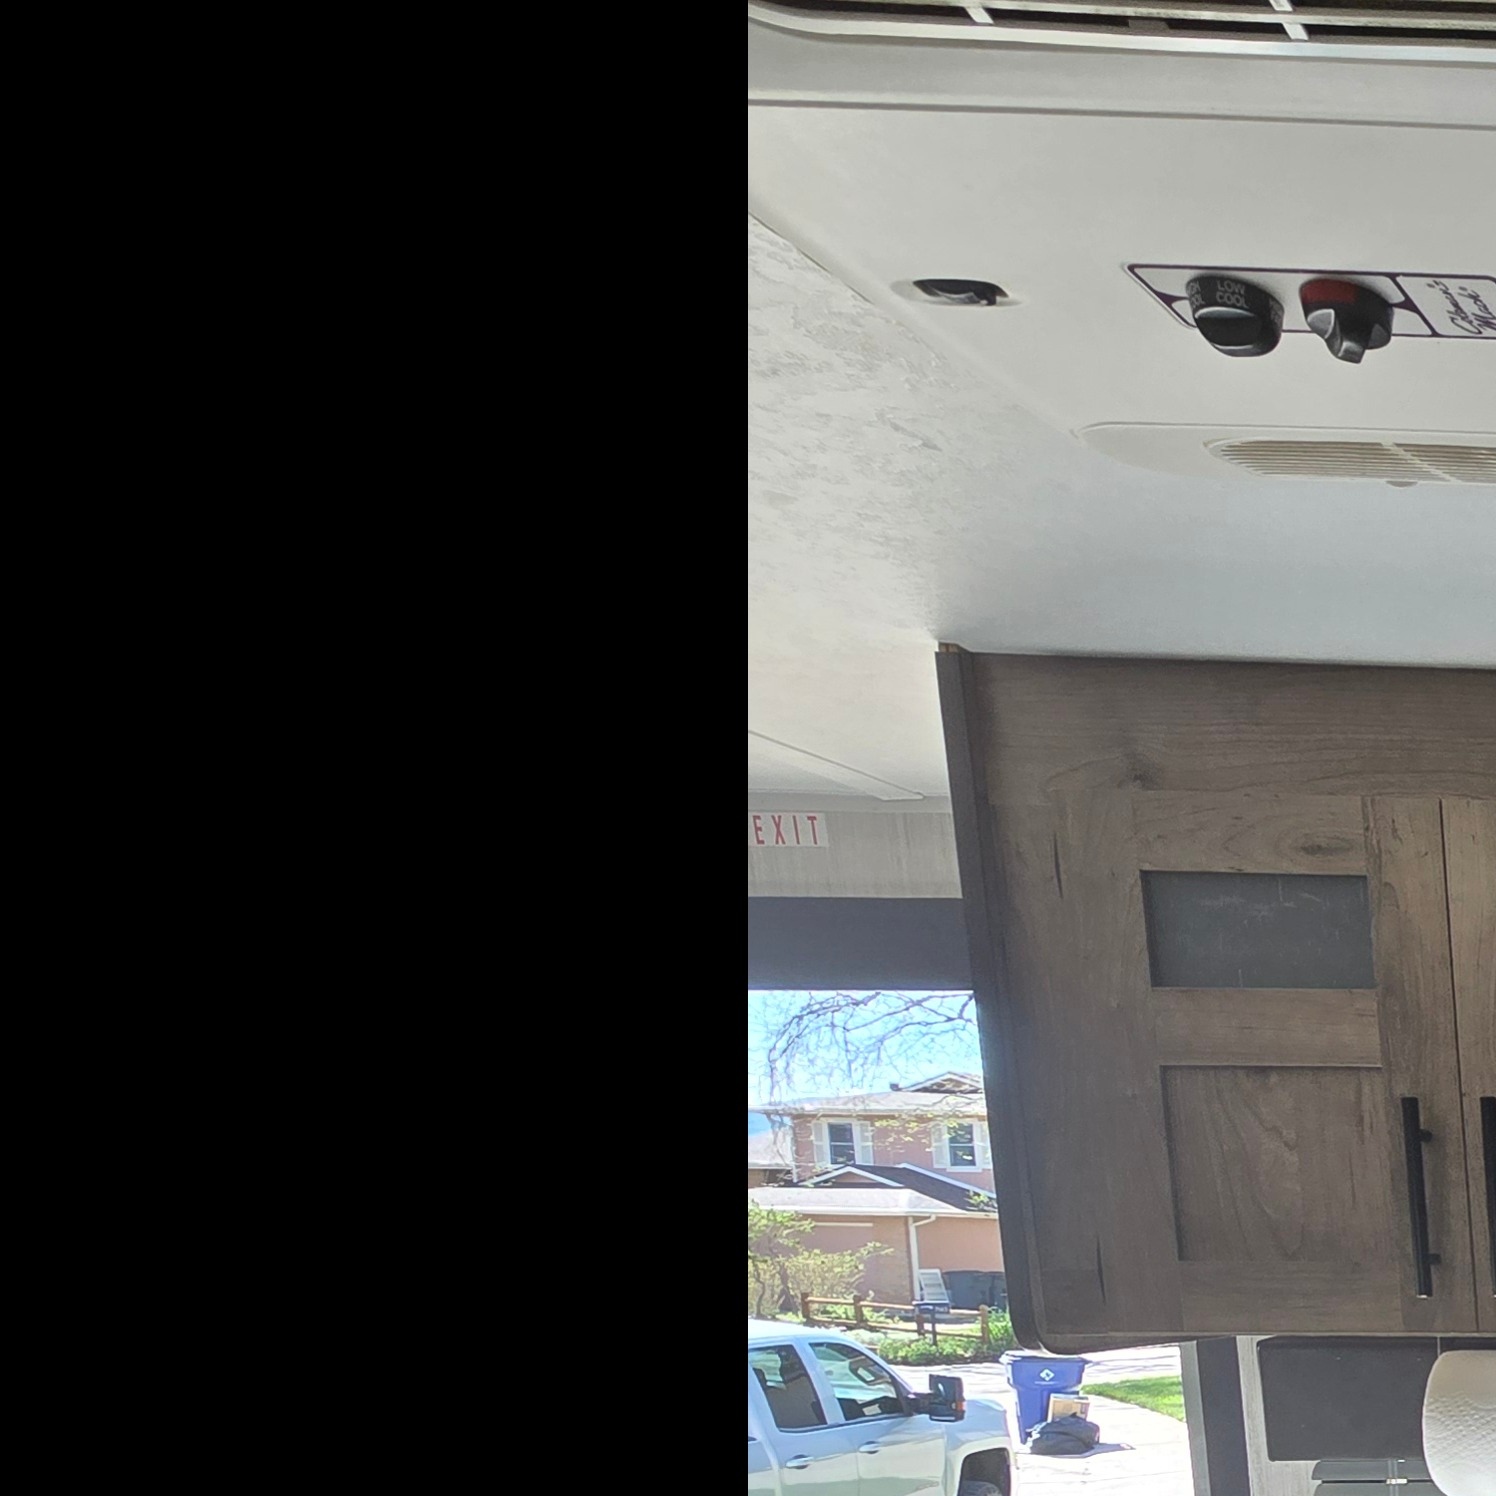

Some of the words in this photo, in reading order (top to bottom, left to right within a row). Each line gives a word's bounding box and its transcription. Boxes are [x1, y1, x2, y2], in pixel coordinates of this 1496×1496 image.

[1217, 280, 1246, 295] LOW
[1216, 291, 1250, 310] COOL
[752, 815, 818, 845] EXIT
